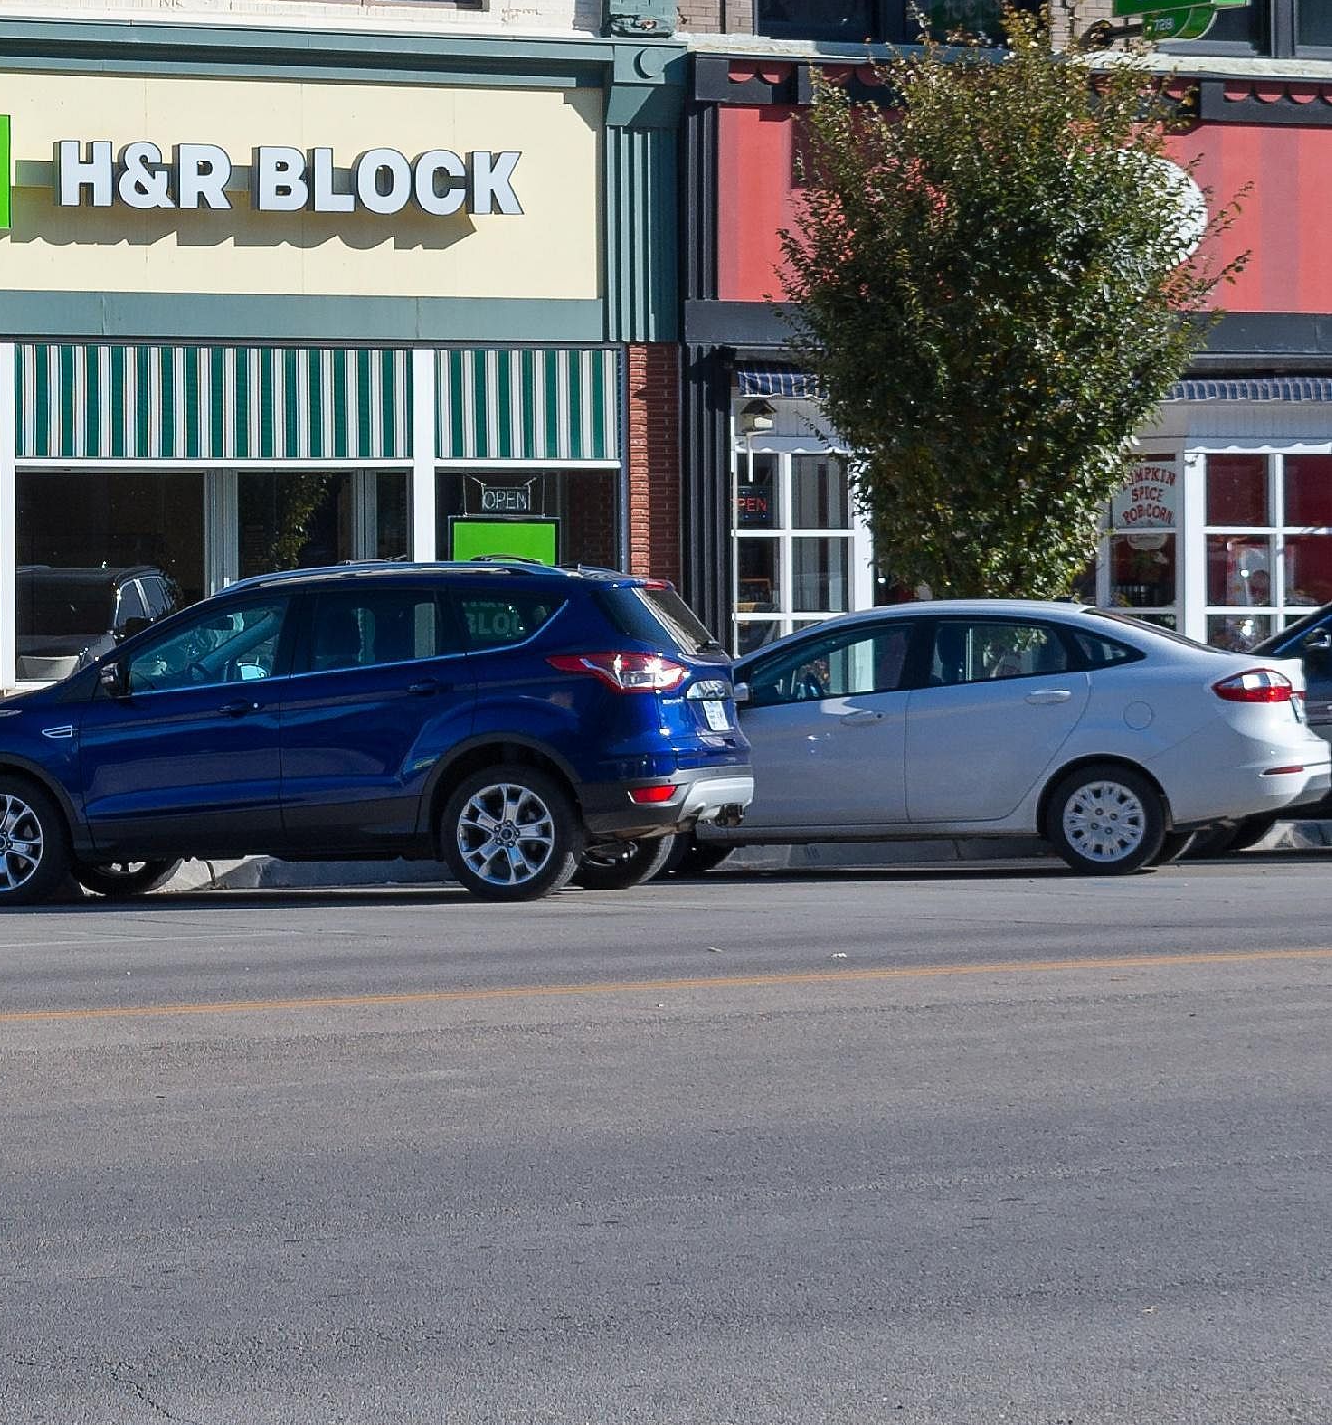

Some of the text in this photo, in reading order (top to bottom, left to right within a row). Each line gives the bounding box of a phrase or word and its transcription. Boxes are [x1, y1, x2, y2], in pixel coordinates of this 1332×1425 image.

[53, 140, 525, 217] H&R BLOCK
[482, 491, 527, 510] OPEN
[735, 485, 768, 513] PEN
[1131, 485, 1164, 503] SPICE
